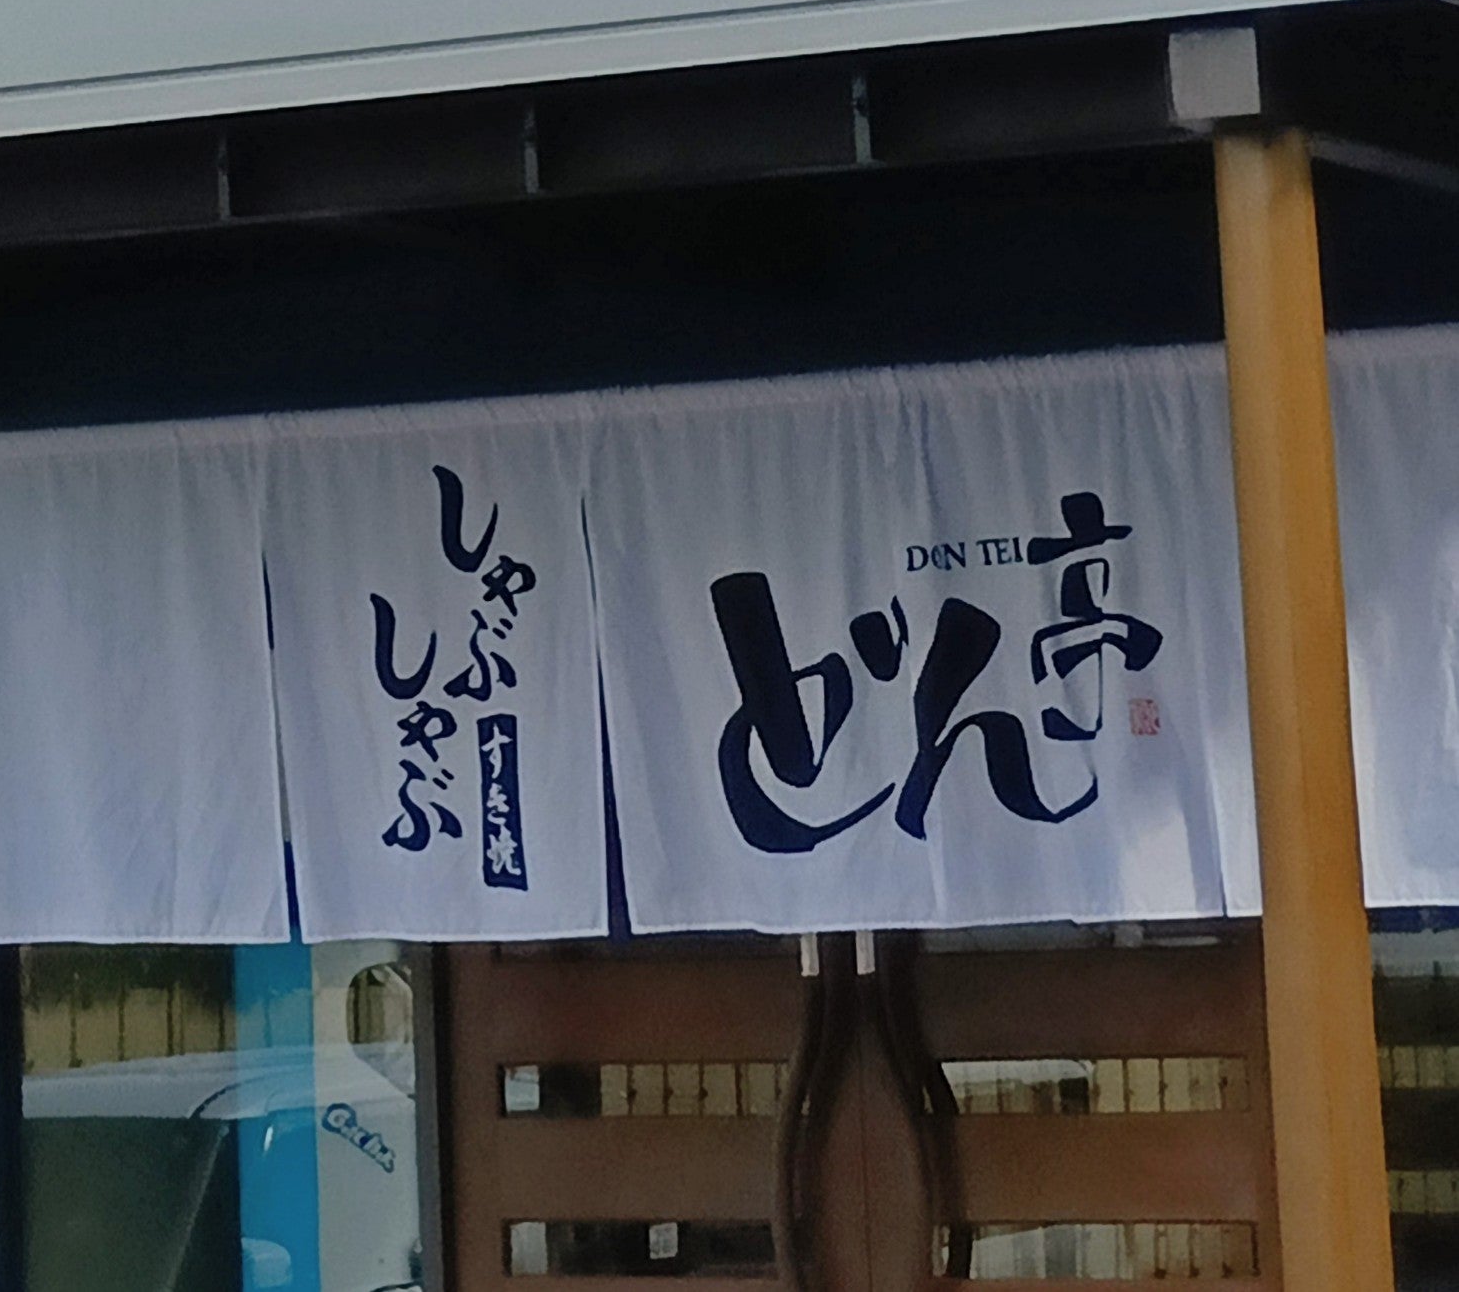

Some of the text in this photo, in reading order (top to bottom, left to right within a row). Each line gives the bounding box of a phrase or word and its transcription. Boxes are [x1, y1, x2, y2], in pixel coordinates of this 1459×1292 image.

[432, 465, 536, 702] しゃぶ
[709, 491, 1164, 854] どん亭
[906, 536, 1023, 572] DON TEI
[369, 592, 463, 852] しゃぶ
[480, 722, 522, 876] すき焼
